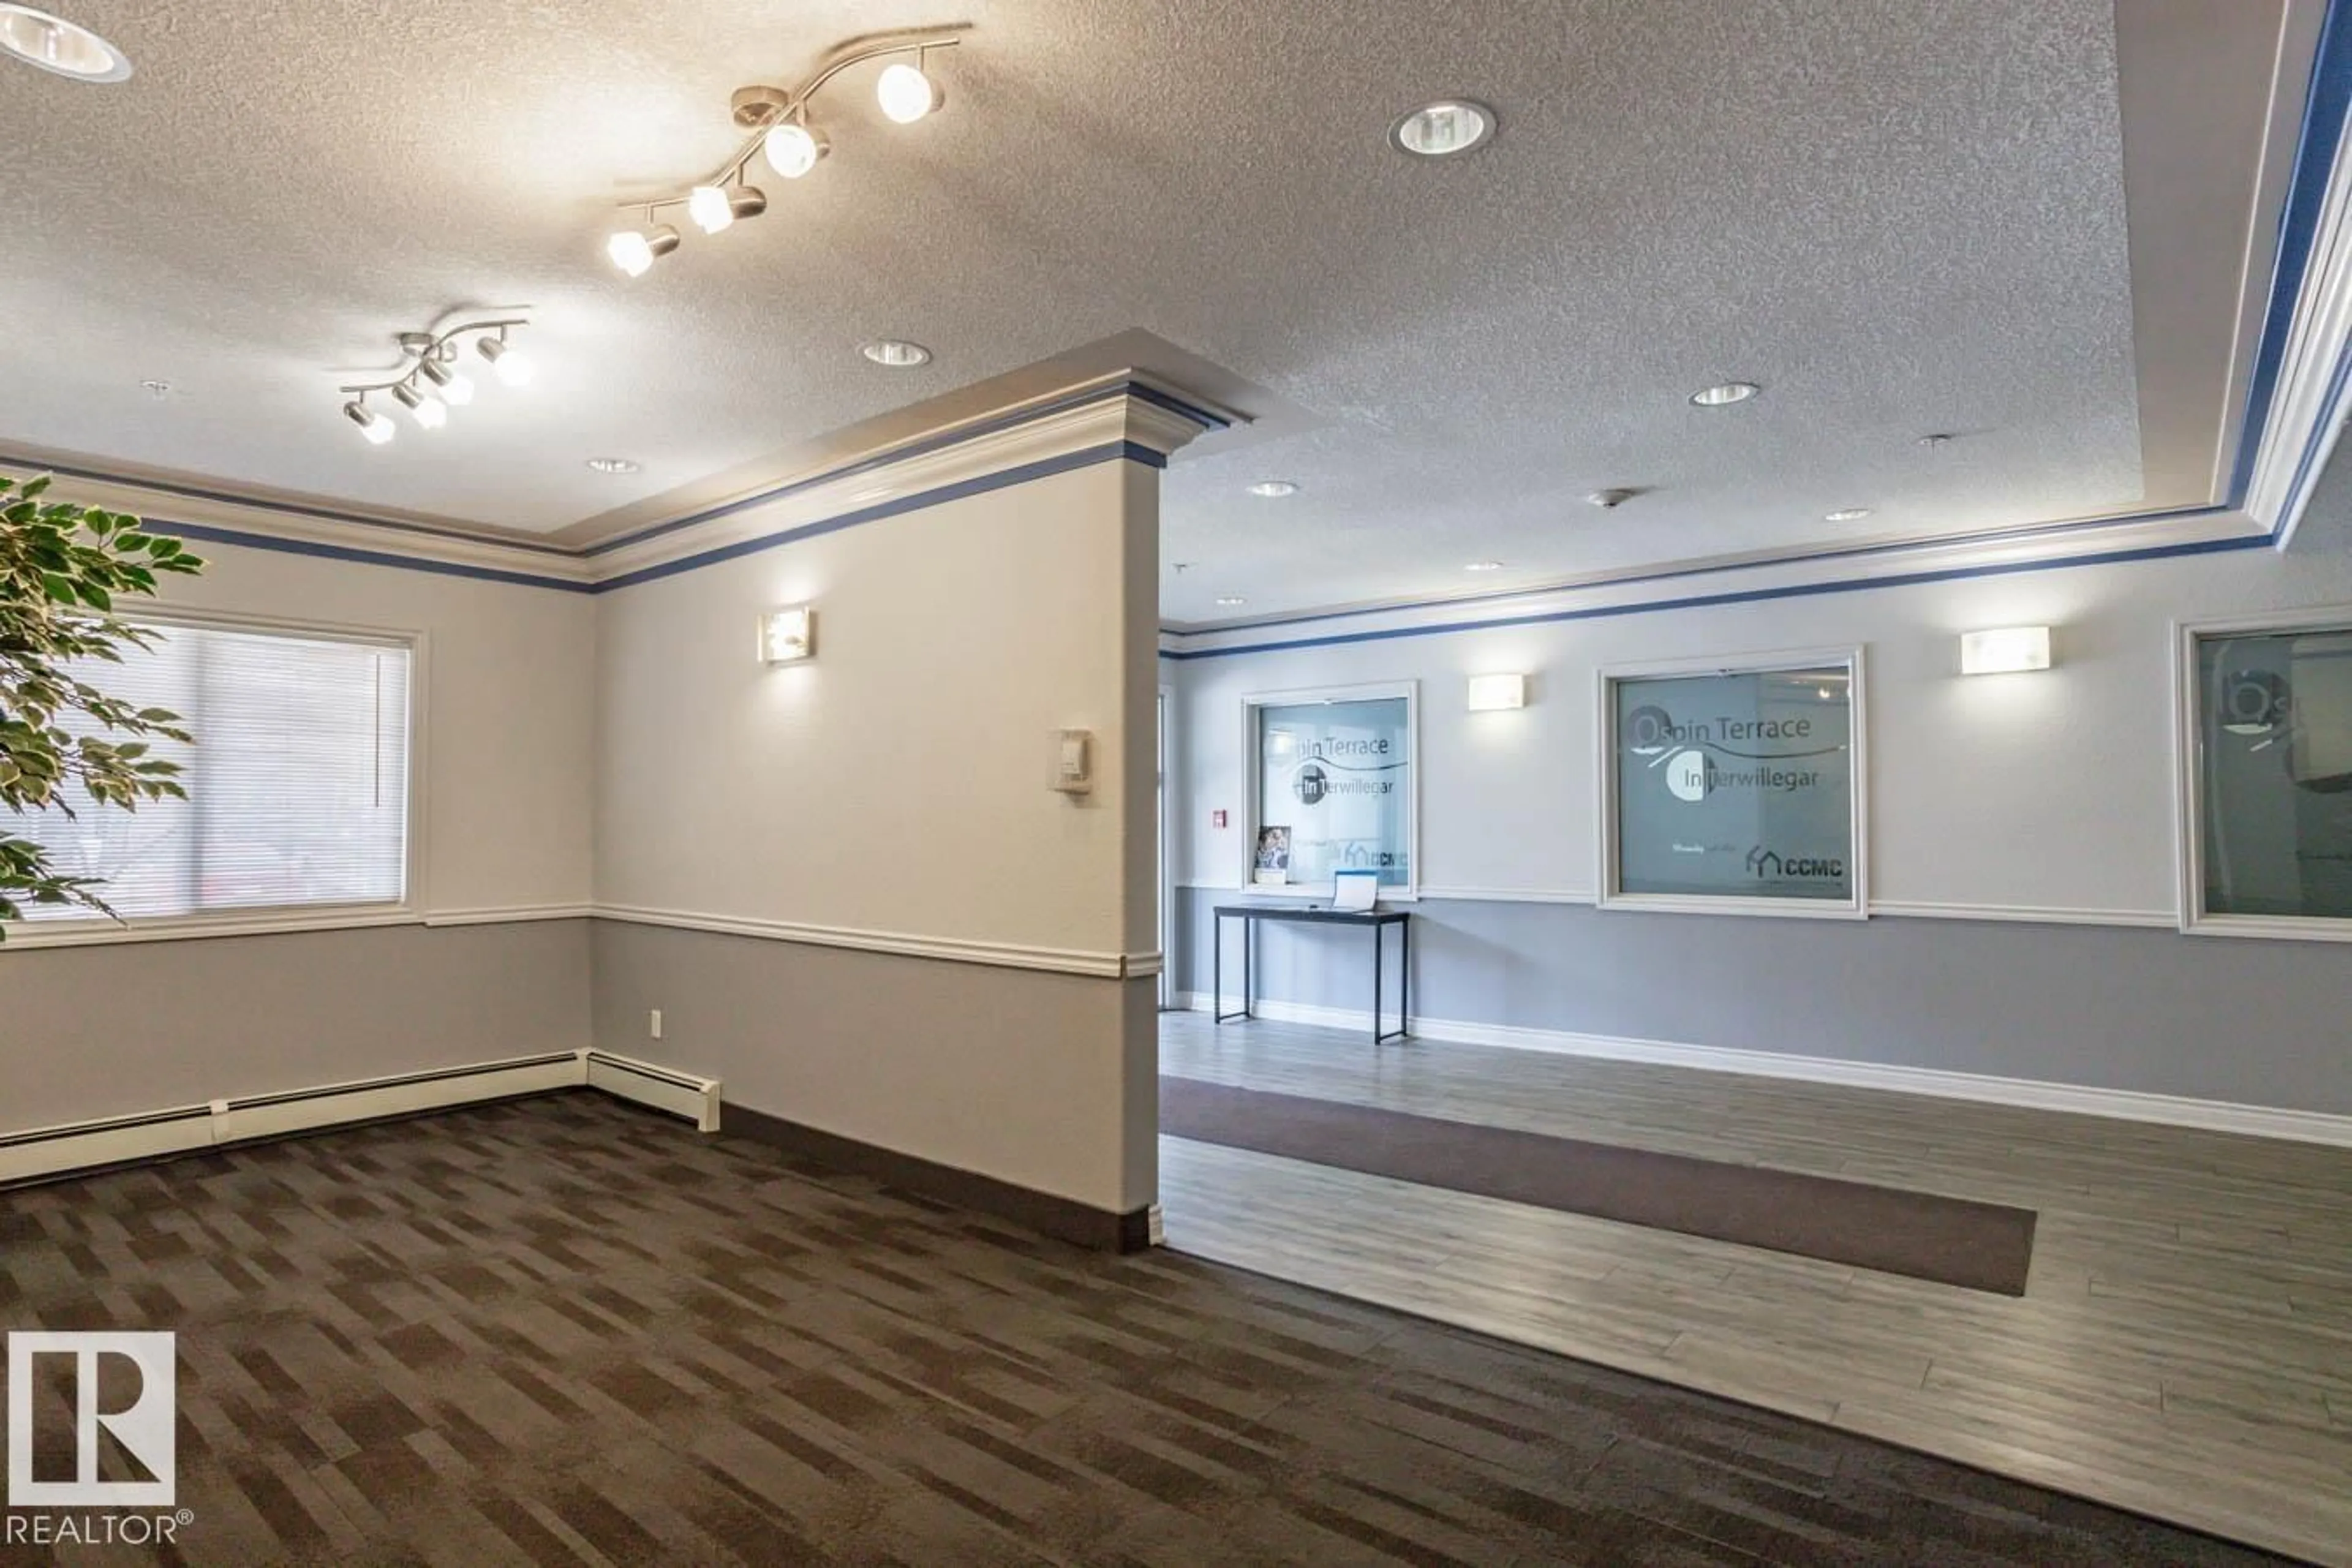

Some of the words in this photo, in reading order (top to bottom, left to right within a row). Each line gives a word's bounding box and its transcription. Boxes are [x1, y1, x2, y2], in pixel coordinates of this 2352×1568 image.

[1716, 717, 1811, 740] Terrace
[1325, 736, 1389, 755] Terrace
[1785, 858, 1842, 876] CCMC
